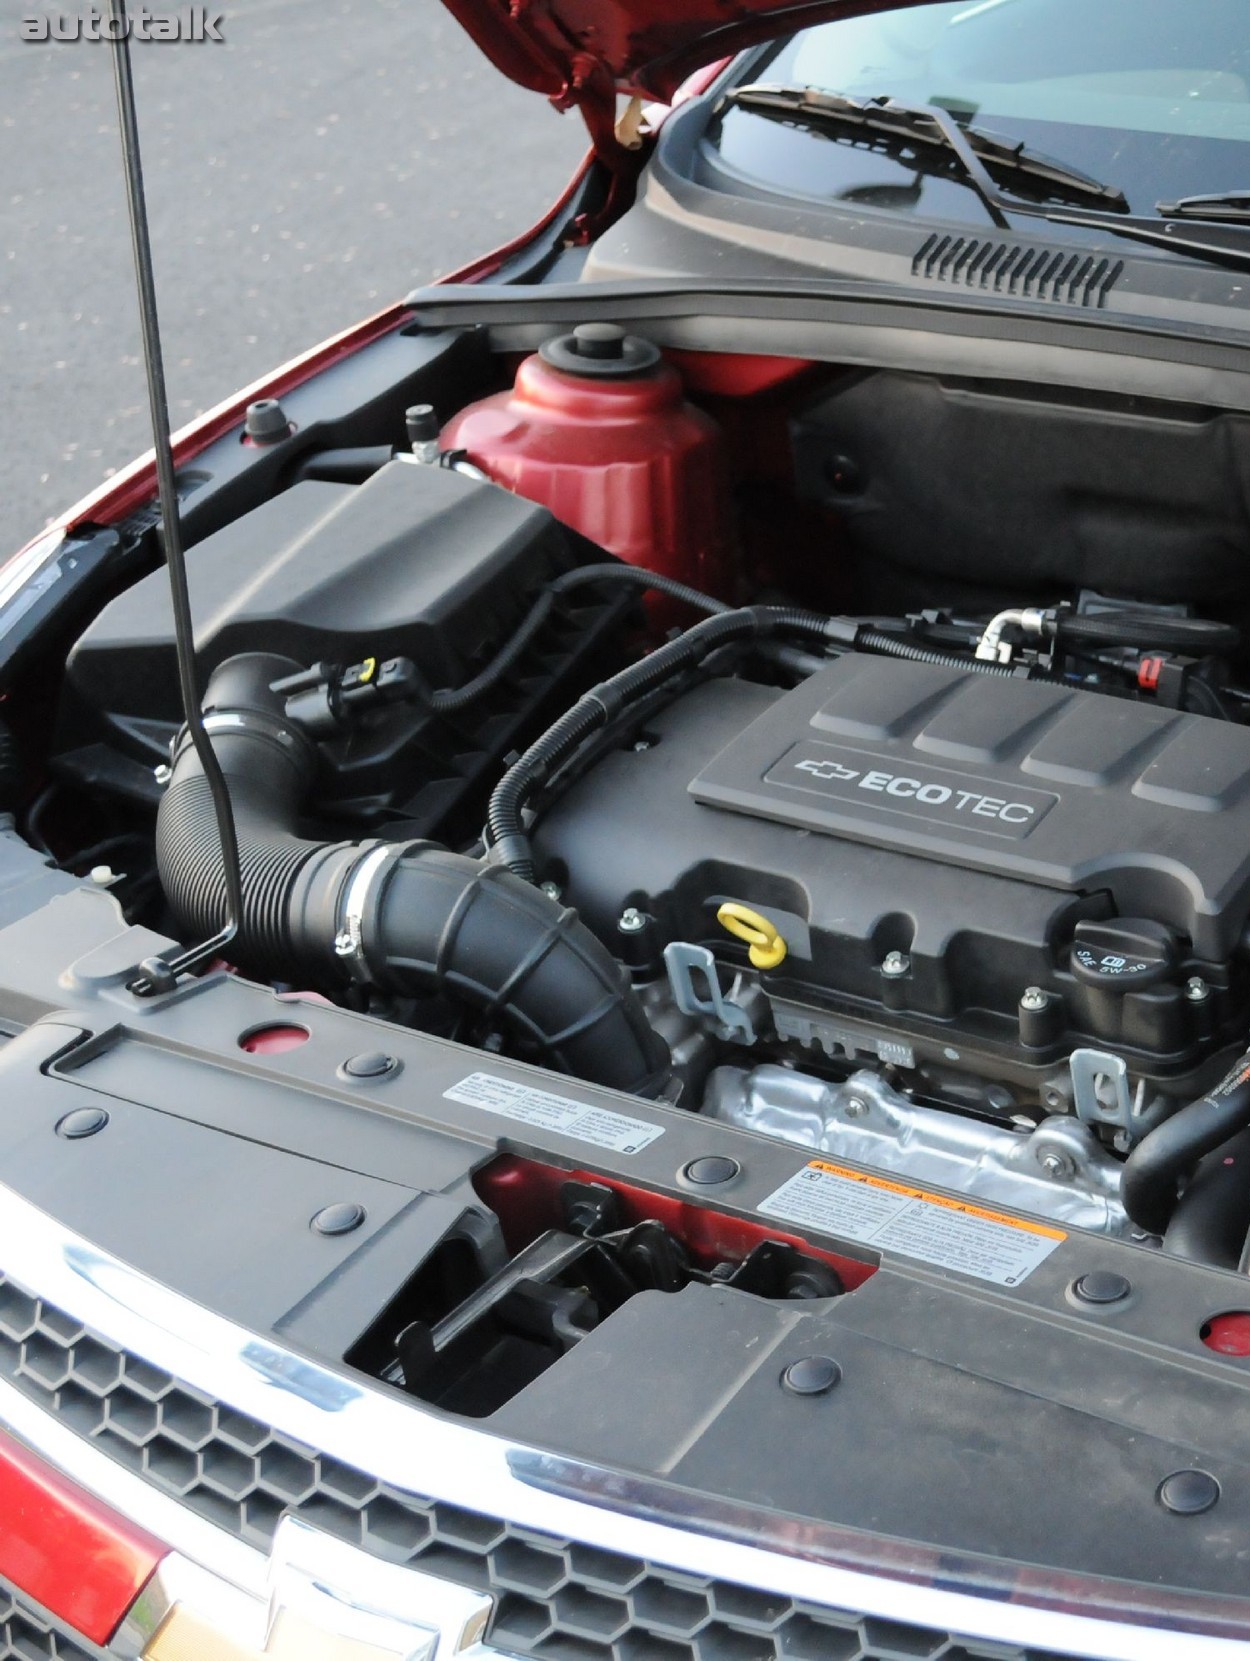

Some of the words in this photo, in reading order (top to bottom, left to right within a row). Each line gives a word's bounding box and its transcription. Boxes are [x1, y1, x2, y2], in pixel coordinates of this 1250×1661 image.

[858, 770, 1035, 823] ECOTEC
[1077, 950, 1097, 967] SAE
[1099, 963, 1147, 974] 5W-30
